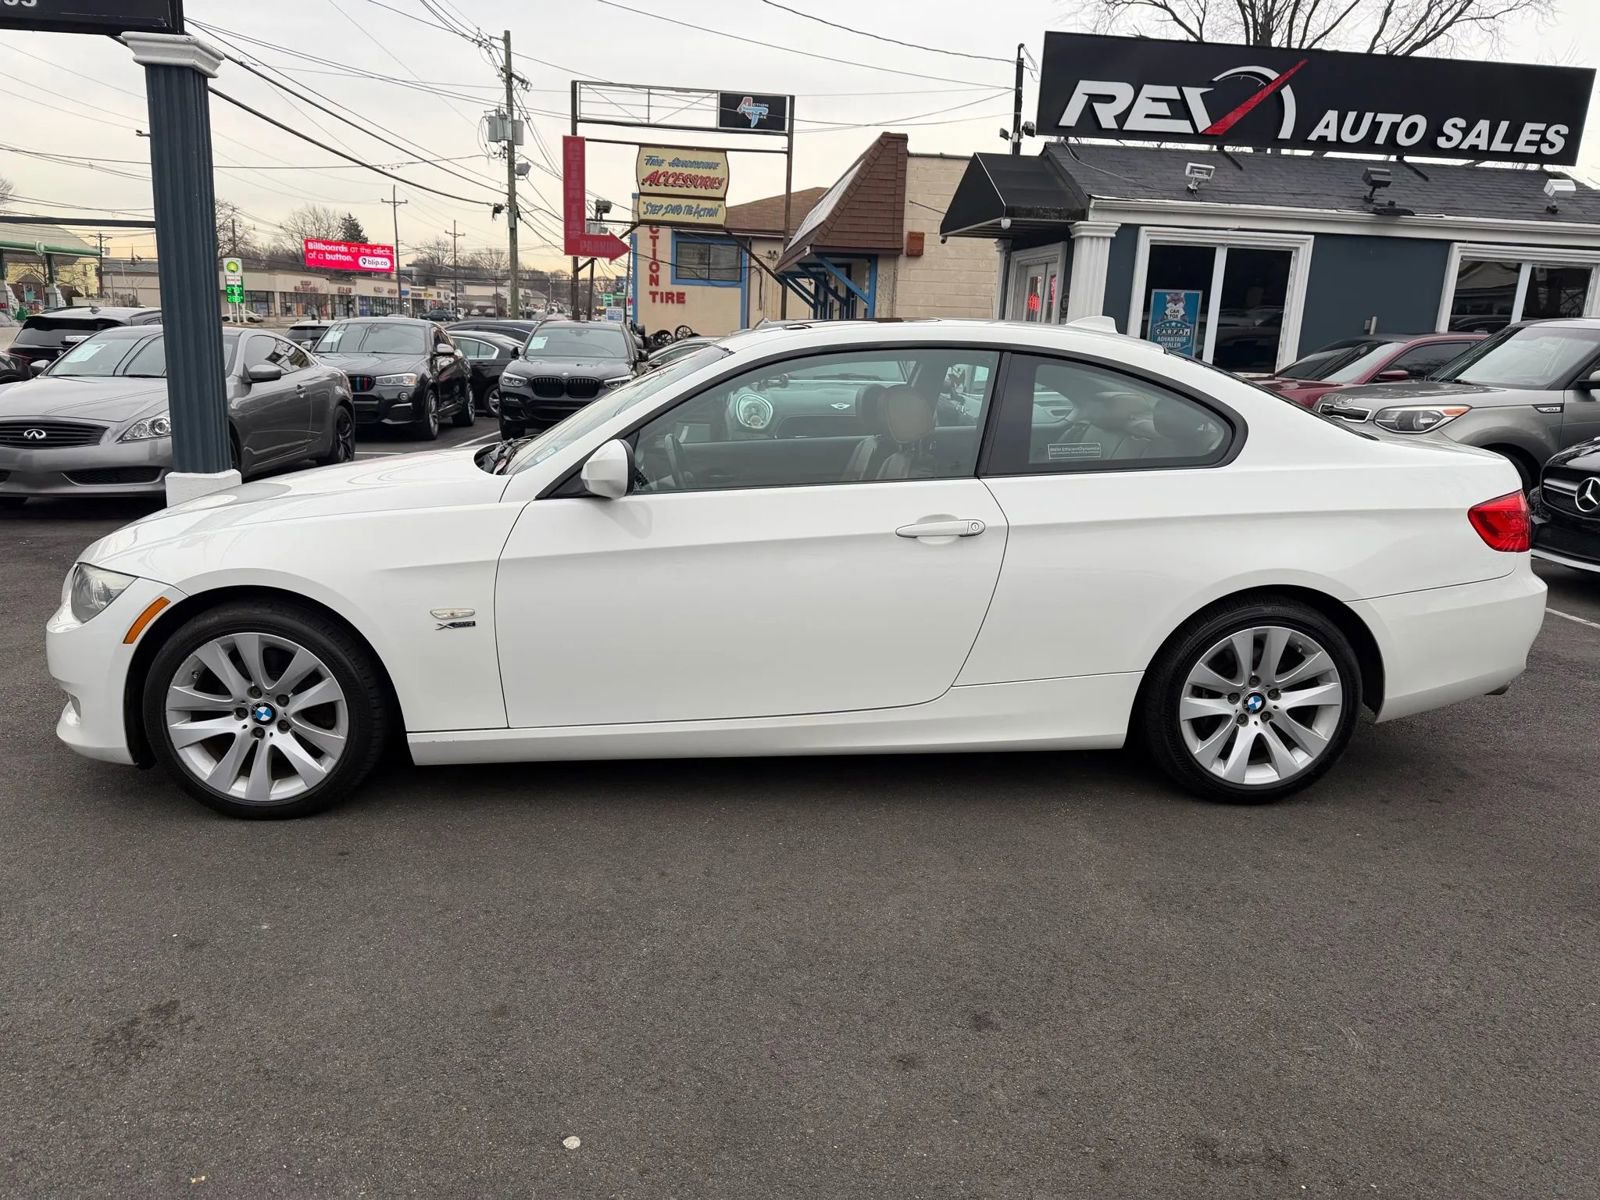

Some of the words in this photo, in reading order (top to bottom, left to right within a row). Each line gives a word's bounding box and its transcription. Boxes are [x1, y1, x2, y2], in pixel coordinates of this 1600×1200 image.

[1307, 109, 1427, 147] AUTO
[1437, 117, 1569, 155] SALES
[641, 170, 725, 190] ACCESSORIES
[308, 242, 348, 252] Billboards
[368, 259, 388, 267] blip.co
[649, 291, 686, 304] TIRE
